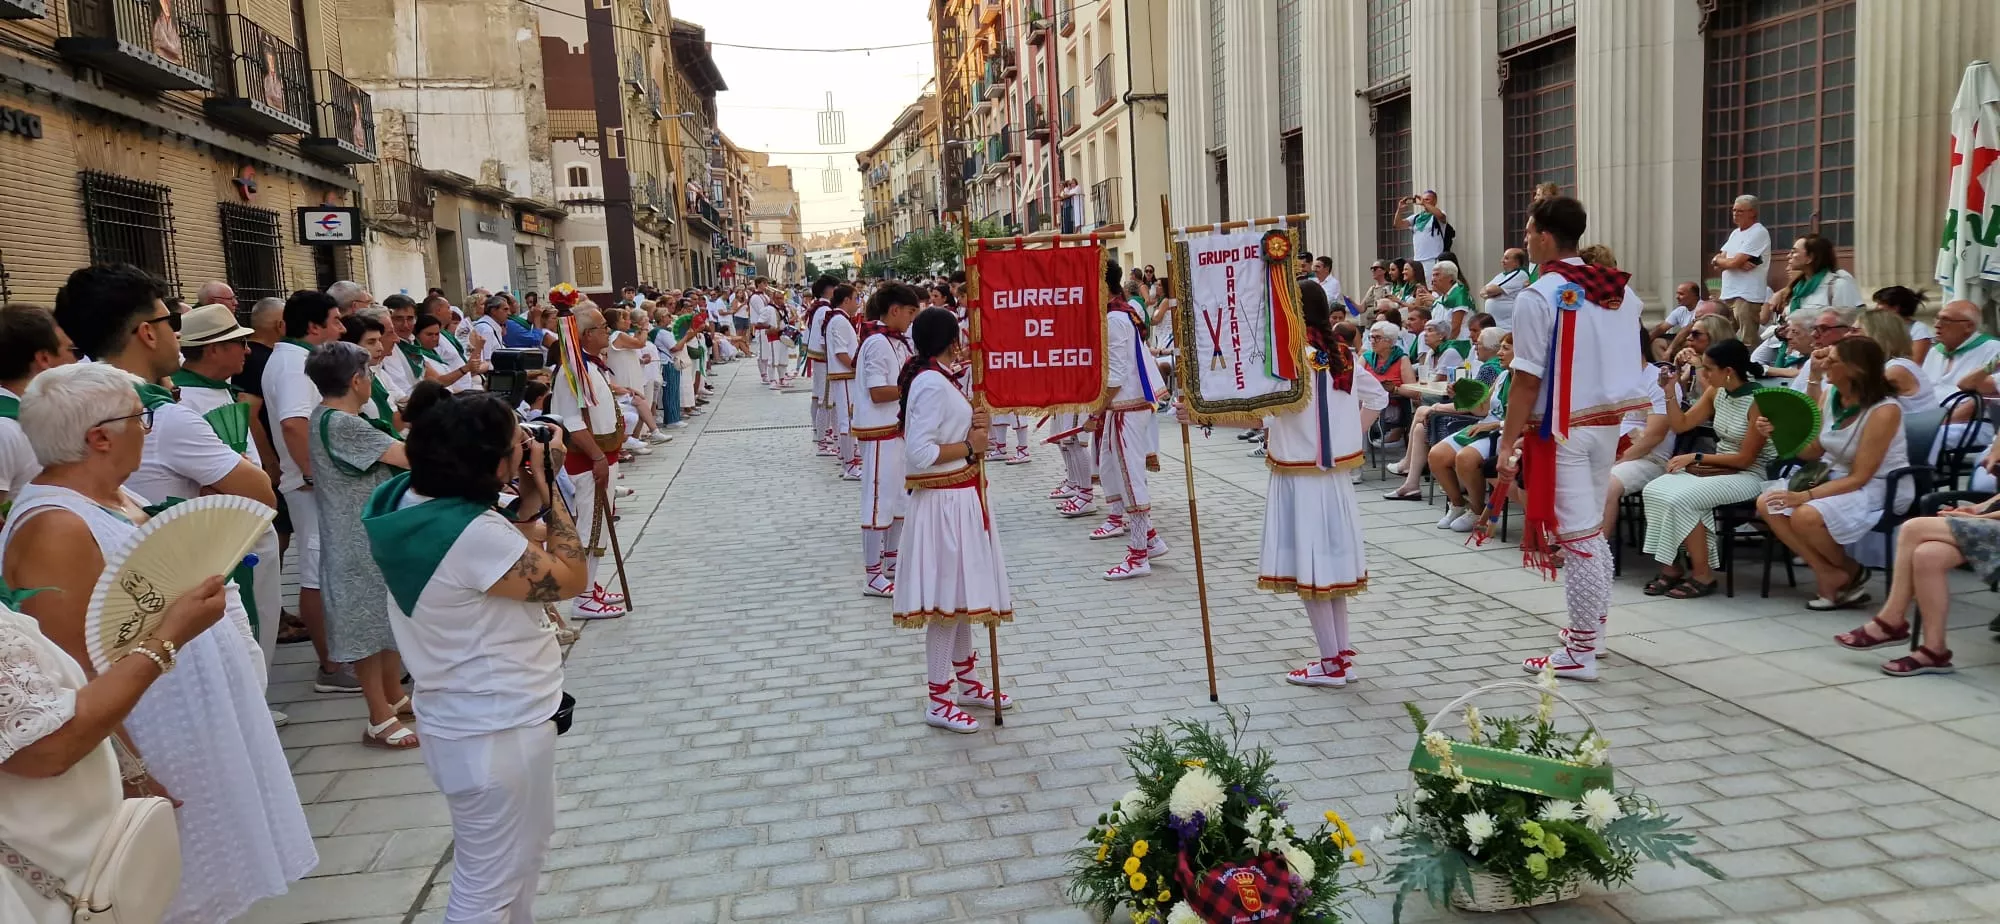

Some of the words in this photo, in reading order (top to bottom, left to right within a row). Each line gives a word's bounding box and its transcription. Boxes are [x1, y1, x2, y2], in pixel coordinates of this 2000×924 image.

[1198, 248, 1239, 266] GRUPO
[1244, 245, 1260, 259] DE
[993, 286, 1084, 309] GURREA
[1025, 319, 1054, 337] DE
[1225, 265, 1245, 390] DANZANTES
[988, 348, 1092, 369] GALLEGO
